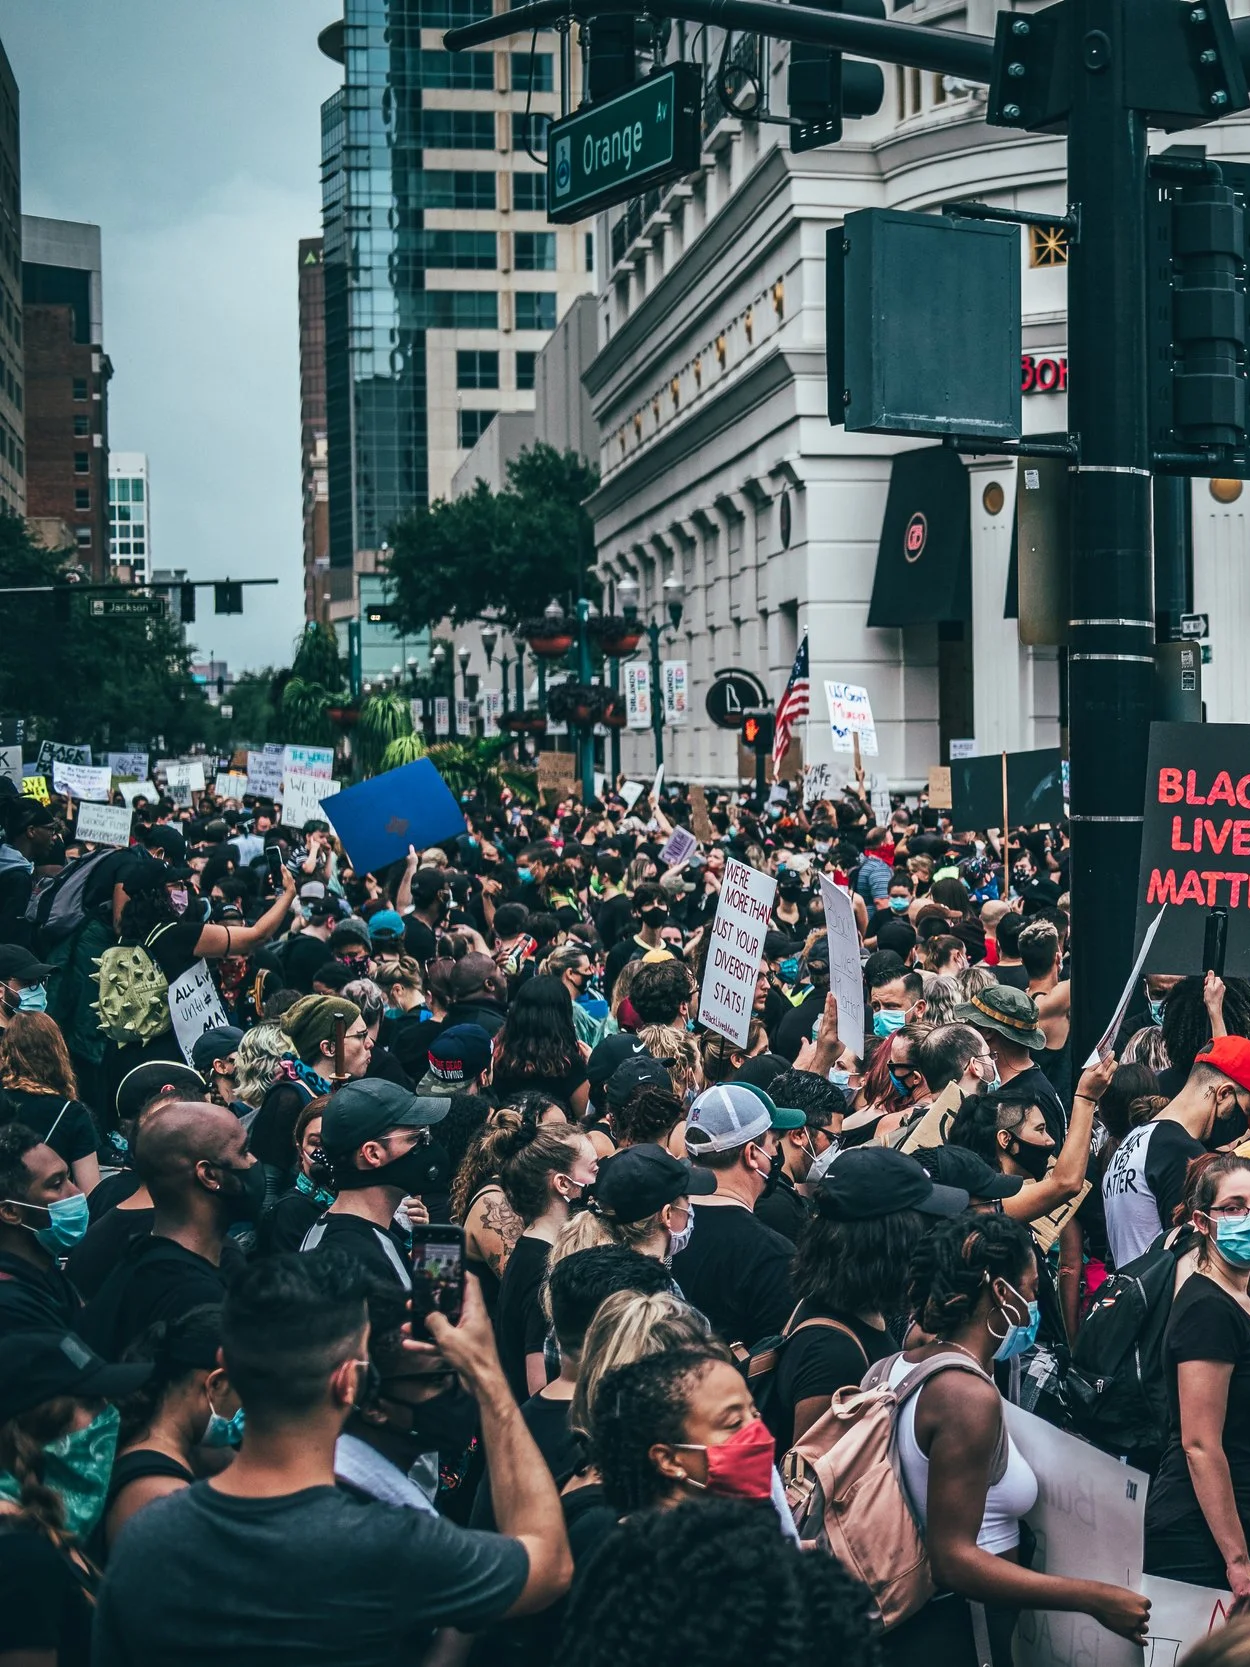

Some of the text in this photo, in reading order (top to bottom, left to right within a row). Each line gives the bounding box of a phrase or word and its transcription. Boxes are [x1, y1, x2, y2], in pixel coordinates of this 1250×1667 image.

[583, 101, 668, 176] Orange Av
[108, 602, 149, 612] Jackson
[726, 862, 751, 891] WE'RE
[724, 886, 772, 926] MORE THAN
[712, 915, 759, 958] JUST YOUR
[714, 947, 758, 987] DIVERSITY
[175, 983, 195, 1004] ALL
[713, 981, 746, 1016] STATS!
[702, 1010, 740, 1040] #BlackLivesMatter
[444, 1069, 464, 1080] LIVING
